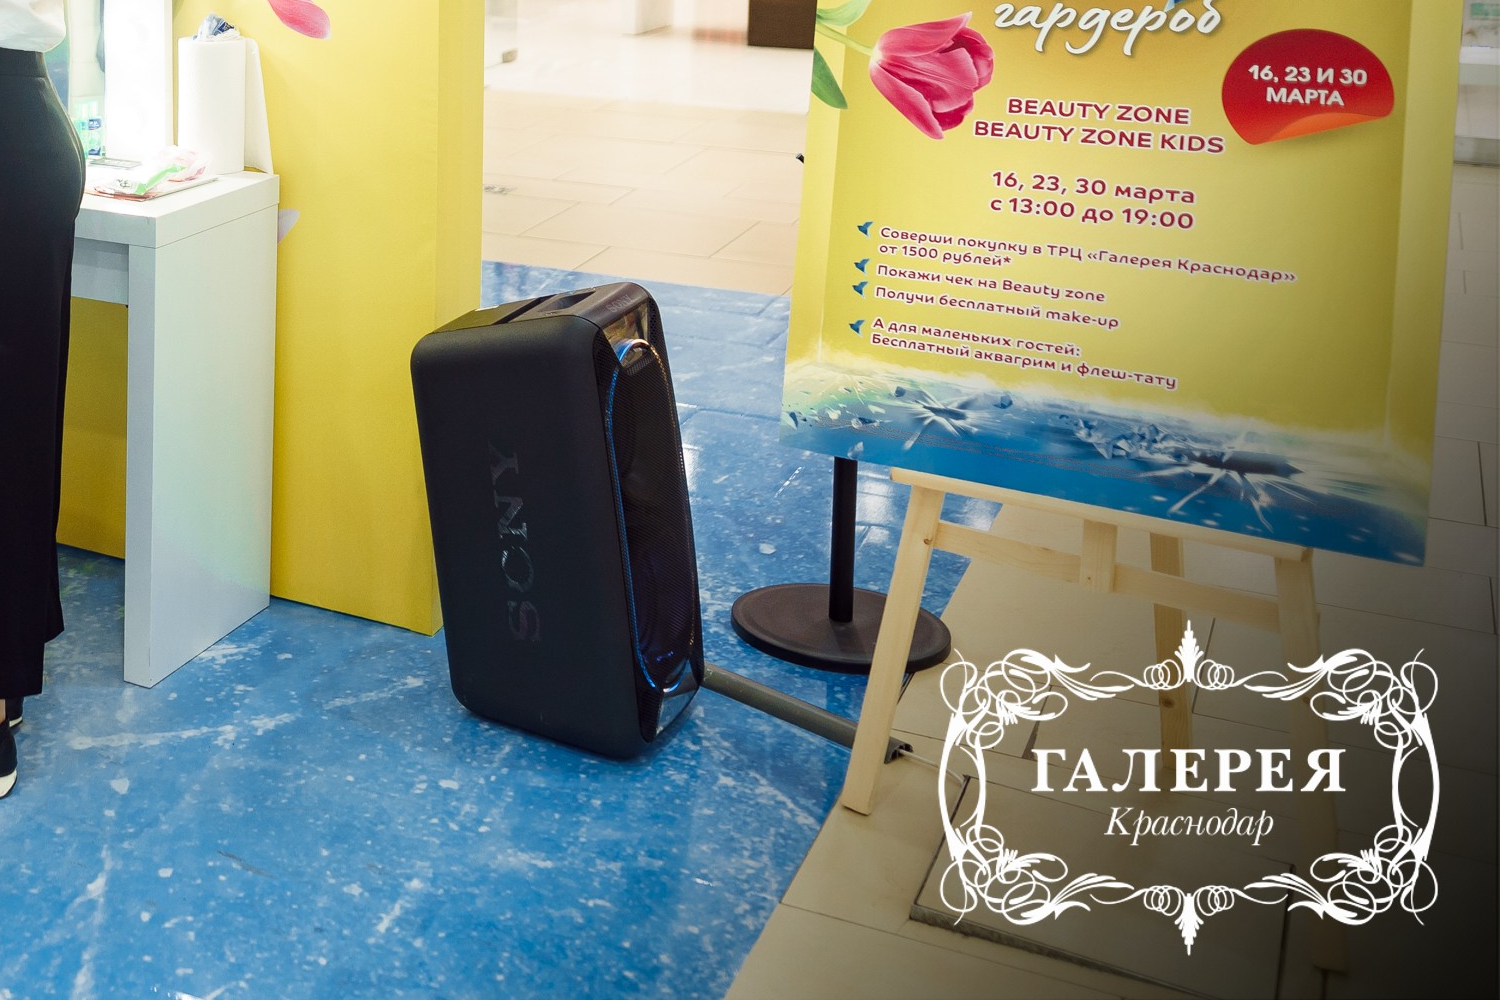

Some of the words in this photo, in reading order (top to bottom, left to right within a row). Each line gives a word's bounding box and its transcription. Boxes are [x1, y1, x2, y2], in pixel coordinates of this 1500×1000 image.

[1248, 65, 1279, 83] 16,
[1284, 66, 1311, 83] 23
[1317, 68, 1334, 84] И
[1339, 68, 1368, 85] 30
[1008, 99, 1110, 119] BEAUTY
[1116, 105, 1189, 125] ZONE
[1266, 87, 1345, 106] МАРТА
[974, 121, 1075, 142] BEAUTY
[1081, 128, 1152, 148] ZONE
[1161, 134, 1224, 153] KIDS
[993, 171, 1024, 191] 16,
[1032, 174, 1067, 195] 23,
[1076, 178, 1106, 195] 30
[1115, 185, 1195, 204] марта
[990, 198, 1002, 211] с
[1009, 198, 1075, 218] 13:00
[1081, 208, 1113, 223] до
[1122, 208, 1193, 229] 19:00
[879, 245, 897, 254] от
[902, 245, 938, 259] 1500
[880, 227, 953, 244] Соверши
[957, 237, 1027, 255] покупку
[1033, 245, 1042, 255] в
[1047, 245, 1082, 261] ТРЦ
[1087, 250, 1172, 268] «Галерея
[1177, 259, 1296, 282] Краснодар»
[877, 265, 941, 282] Покажи
[945, 275, 973, 286] чек
[978, 279, 997, 290] на
[1003, 280, 1060, 299] Beauty
[1065, 289, 1105, 302] zone
[876, 287, 935, 304] Получи
[939, 296, 1041, 318] бесплатный
[1046, 311, 1119, 329] make-up
[873, 319, 884, 330] А
[888, 322, 917, 334] для
[922, 327, 1012, 348] маленьких
[1017, 340, 1080, 357] гостей:
[872, 334, 970, 358] Бесплатный
[974, 350, 1055, 369] аквагрим
[1061, 363, 1072, 373] и
[1077, 362, 1176, 389] флеш-тату
[487, 439, 541, 644] SONY
